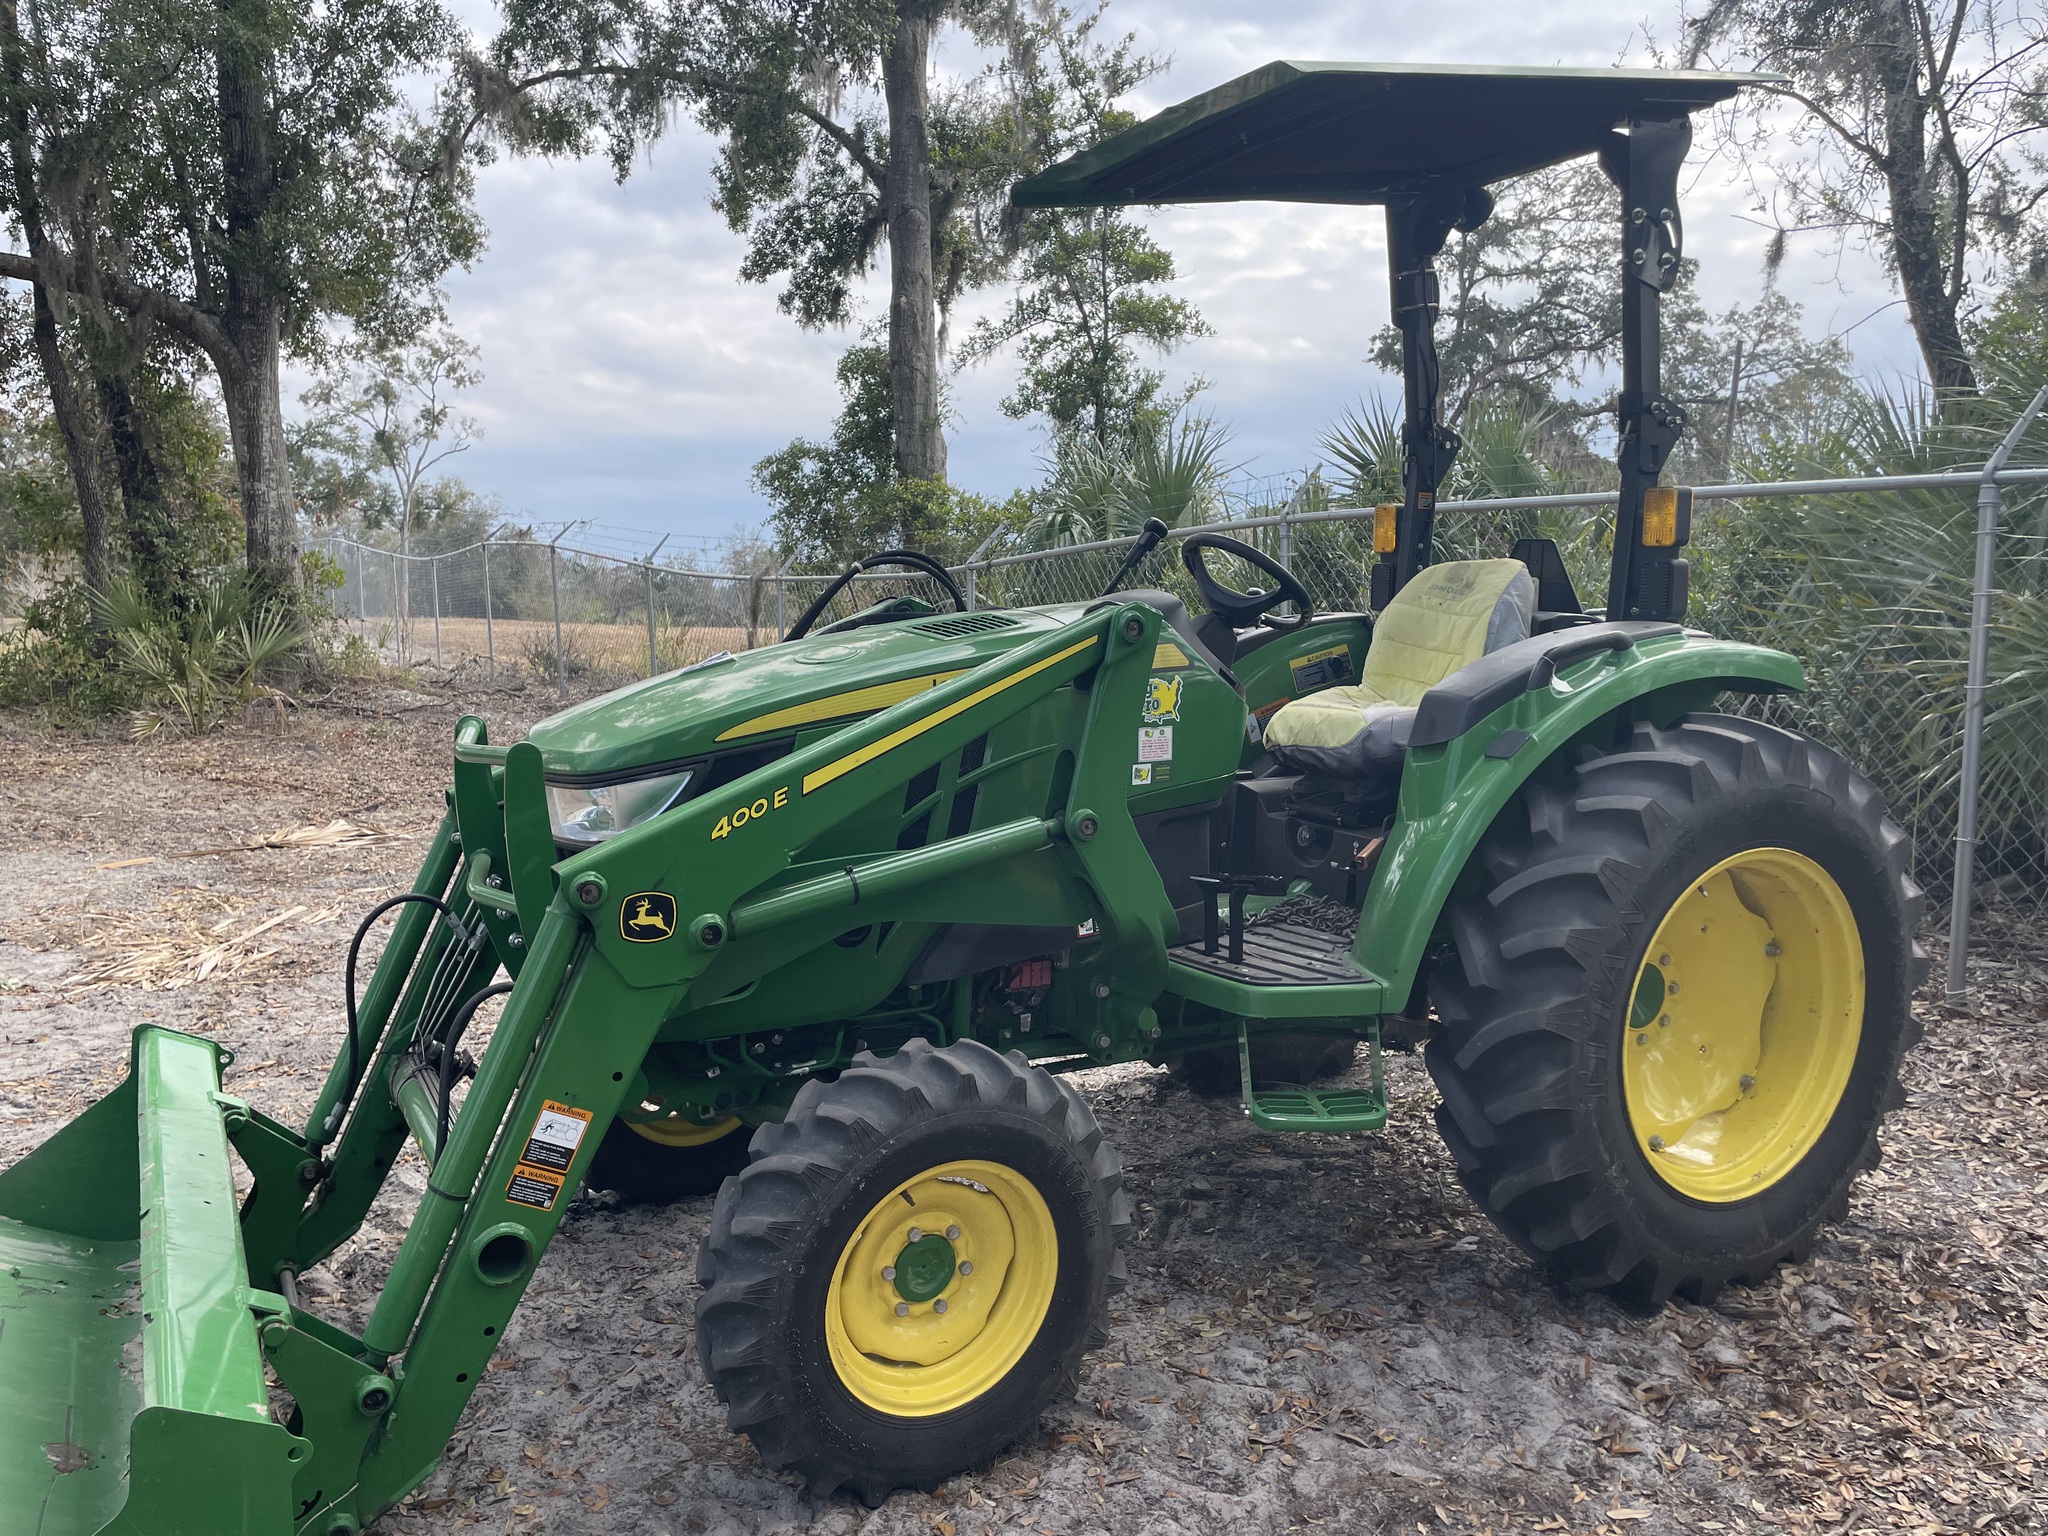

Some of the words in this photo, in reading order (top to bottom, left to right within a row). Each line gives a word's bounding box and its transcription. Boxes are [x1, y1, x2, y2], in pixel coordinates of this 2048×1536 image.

[1311, 651, 1333, 661] CAUTION
[556, 1105, 587, 1119] WARNING
[528, 1170, 559, 1184] WARNING
[1048, 1146, 1100, 1229] TITAN
